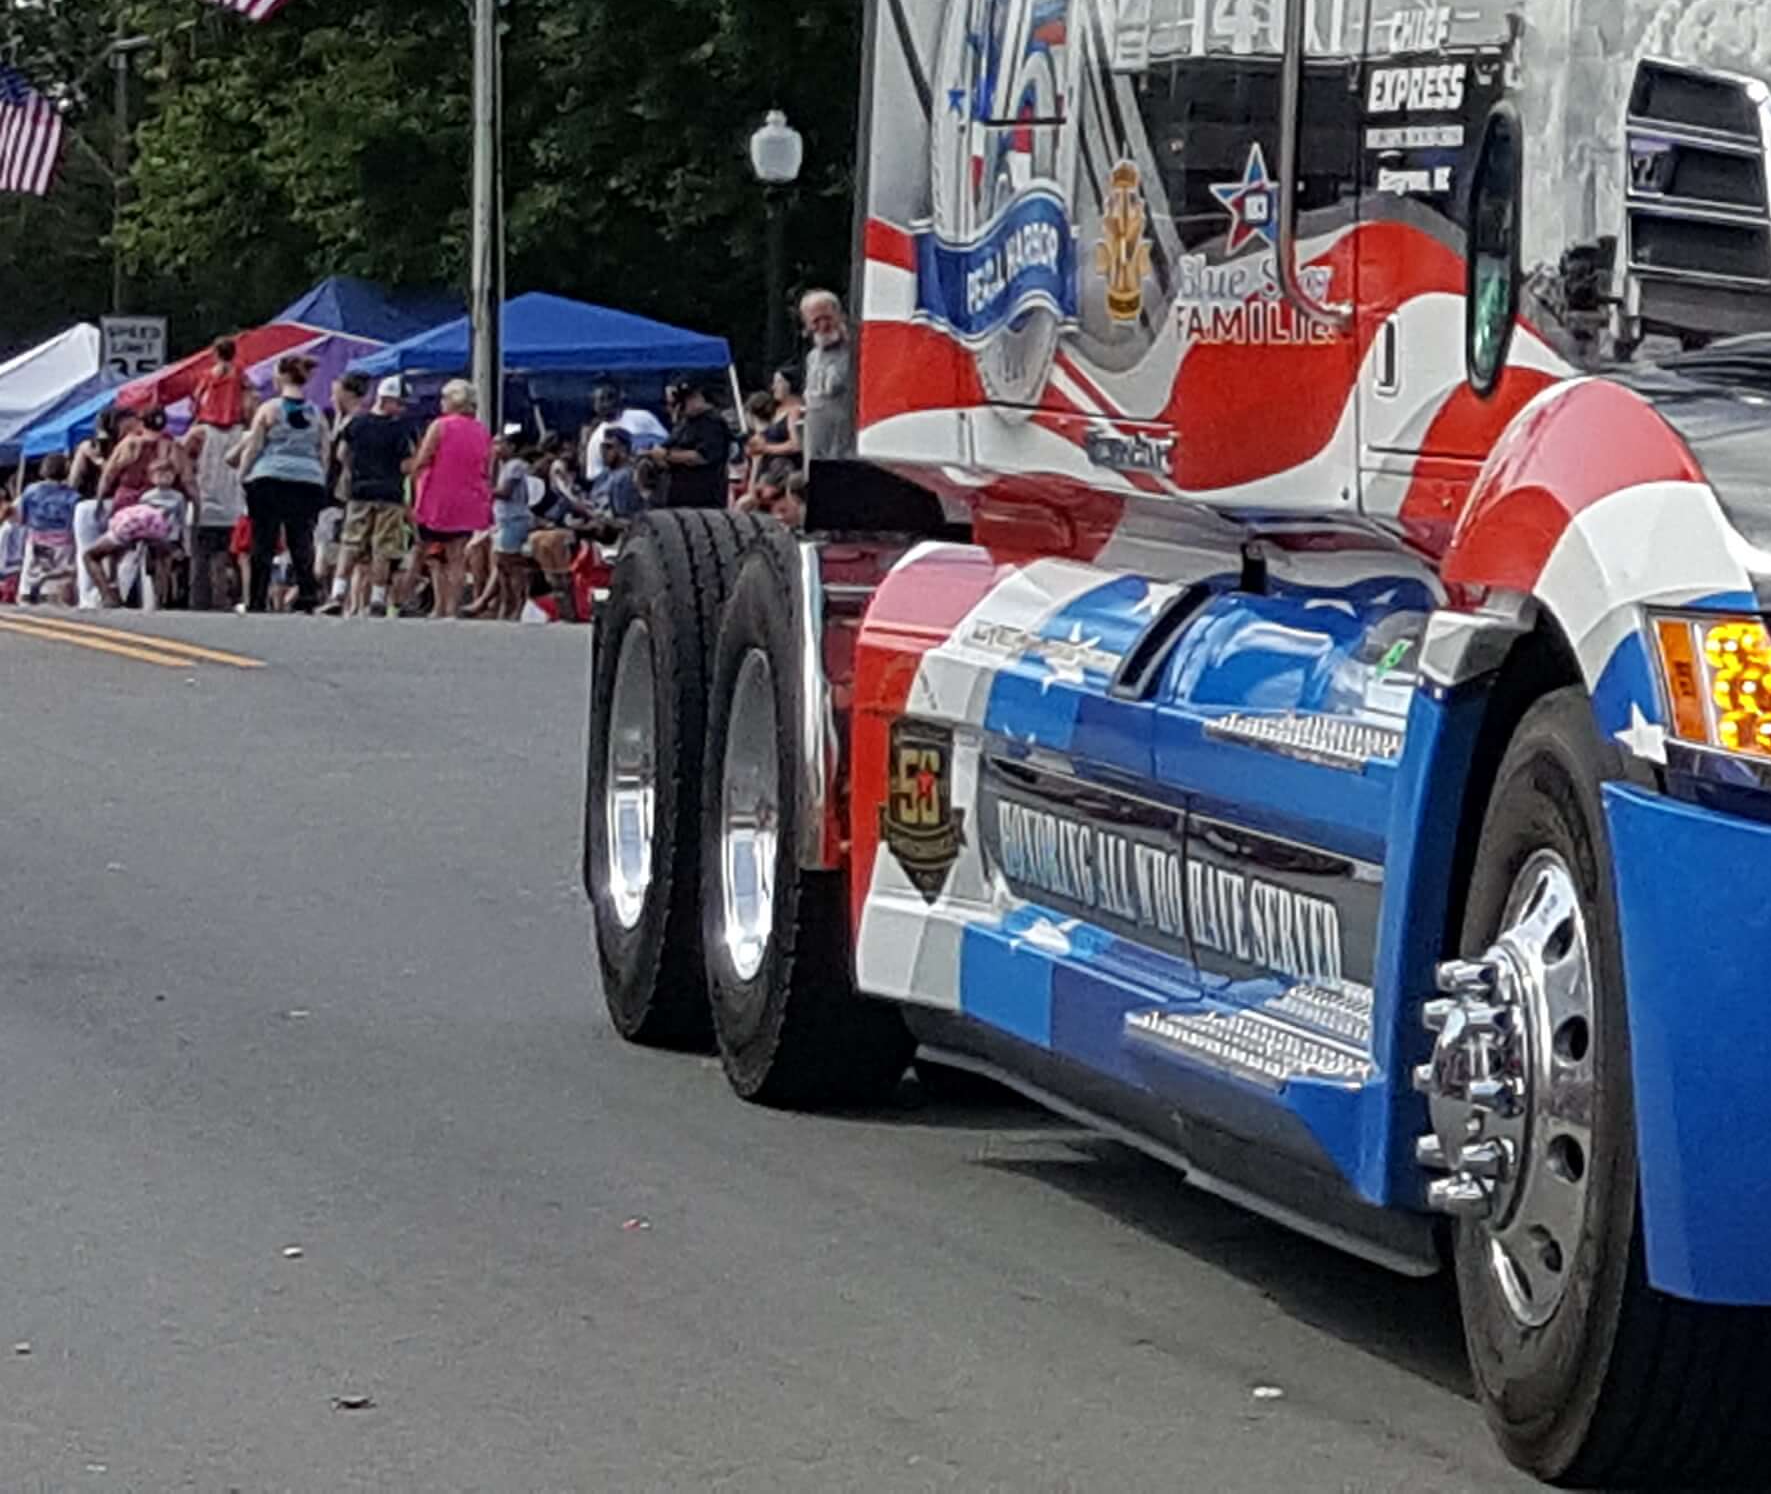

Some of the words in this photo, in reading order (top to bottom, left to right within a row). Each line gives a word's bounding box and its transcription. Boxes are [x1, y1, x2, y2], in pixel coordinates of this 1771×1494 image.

[1390, 6, 1450, 53] CHIEF
[1368, 63, 1466, 112] EXPRESS
[1176, 302, 1338, 346] FAMILIE
[1097, 831, 1139, 921] ALL
[1187, 859, 1249, 961] HAVE
[1250, 878, 1344, 988] SERVED
